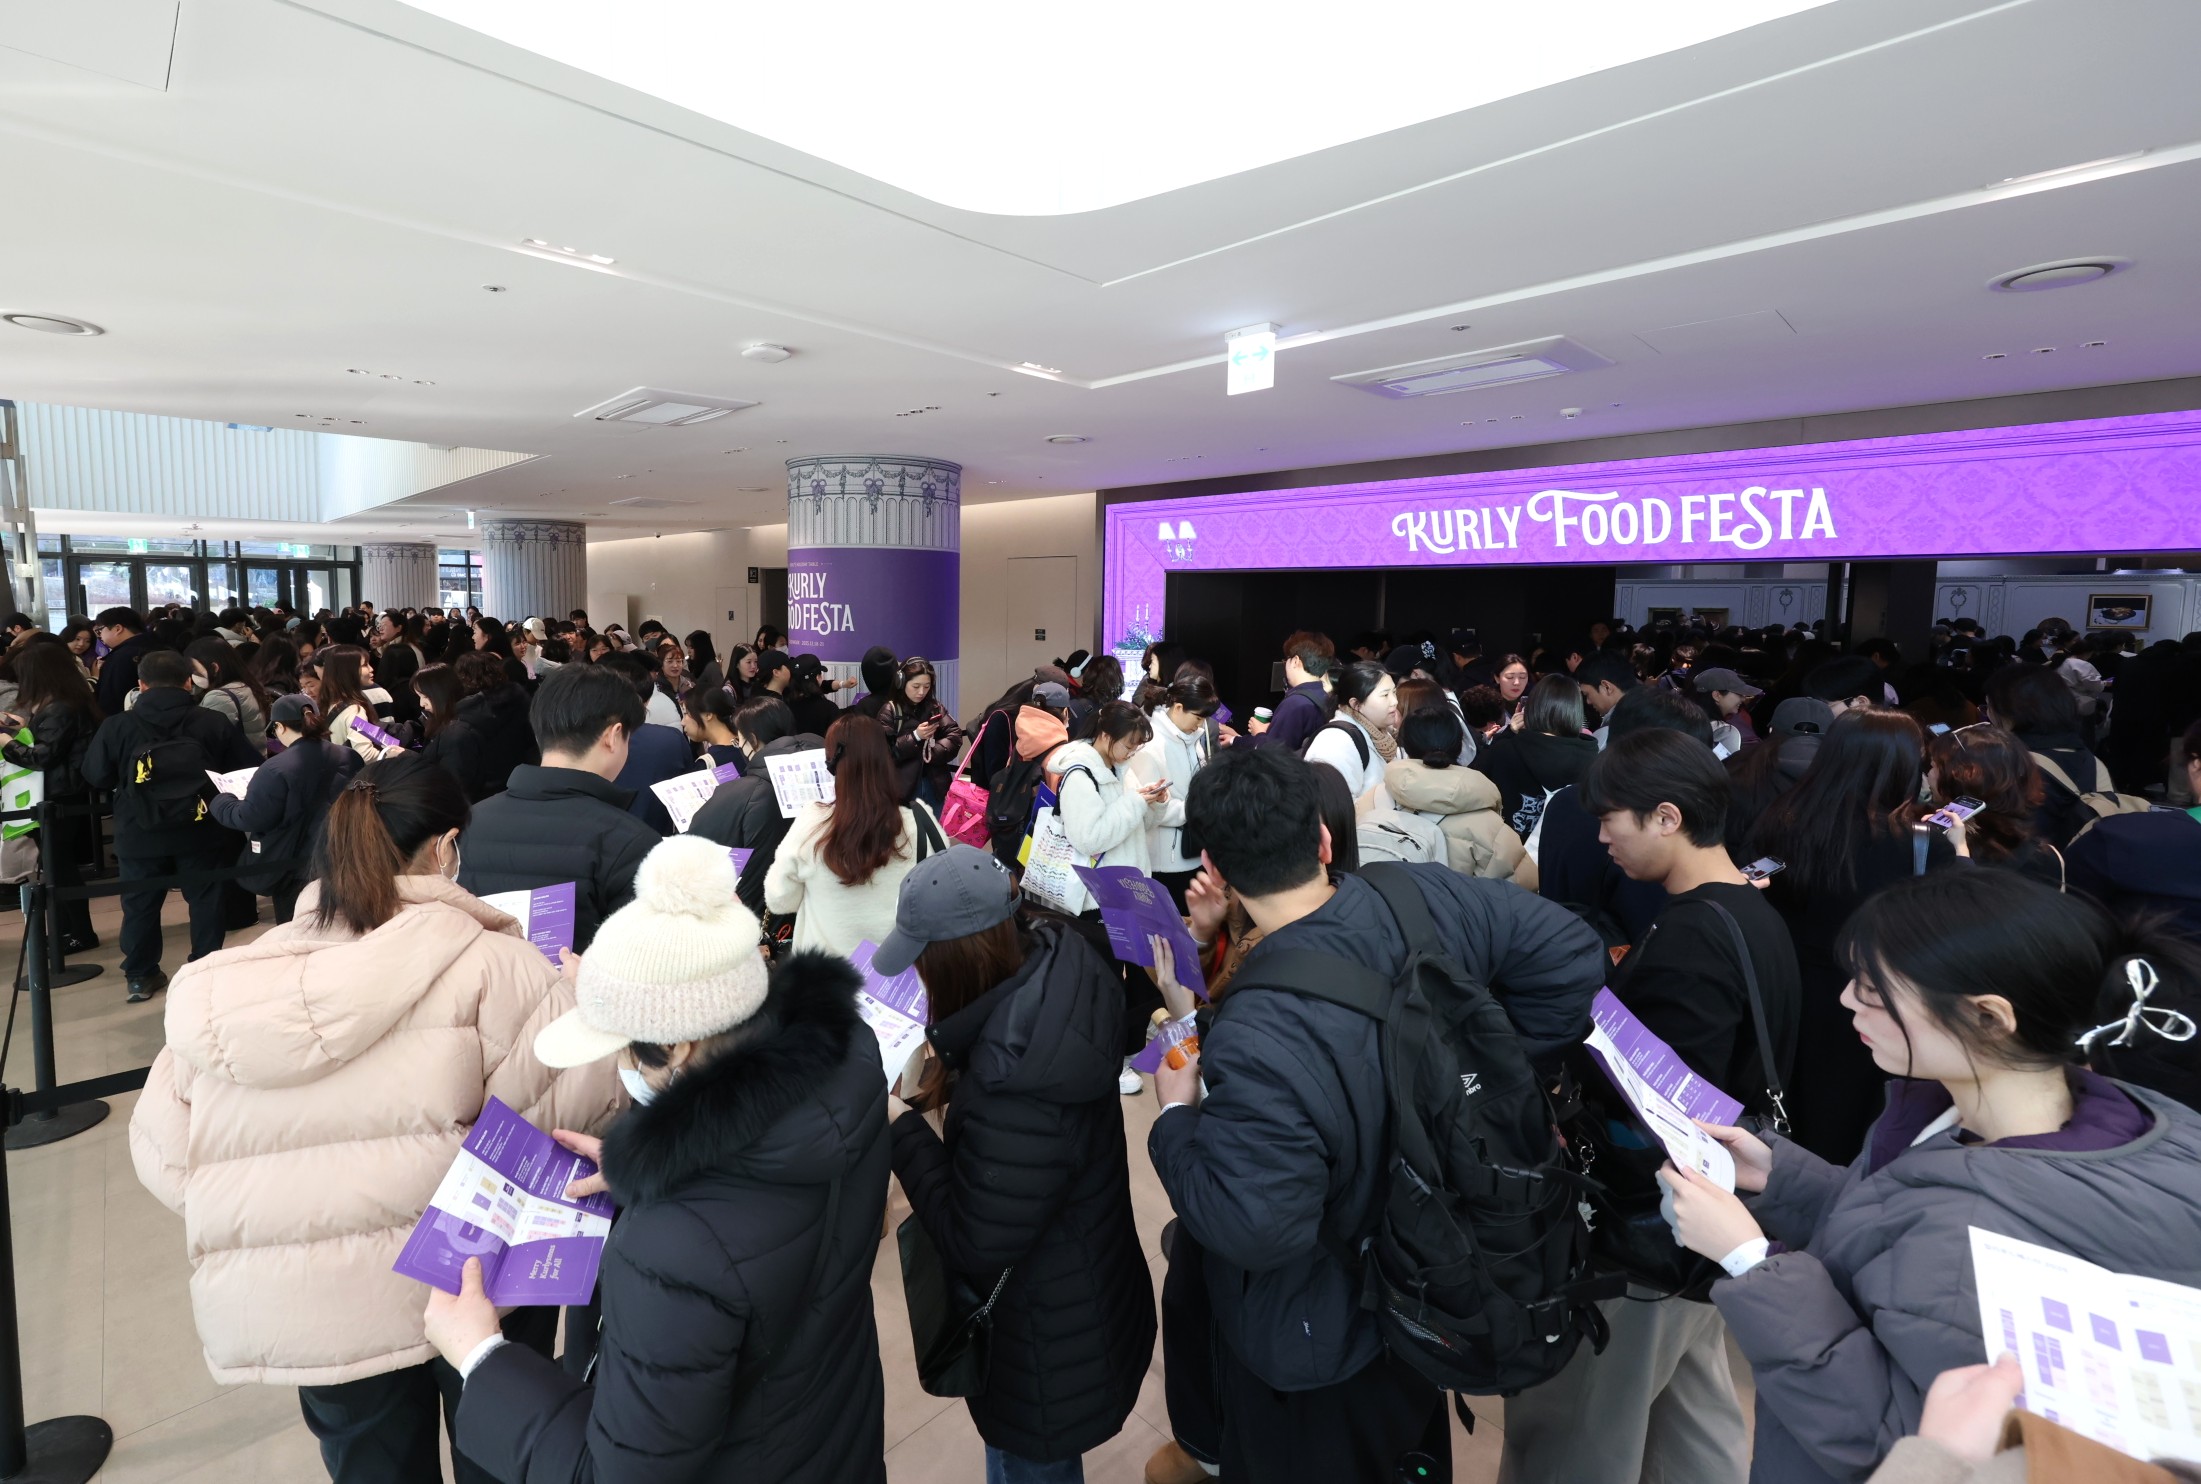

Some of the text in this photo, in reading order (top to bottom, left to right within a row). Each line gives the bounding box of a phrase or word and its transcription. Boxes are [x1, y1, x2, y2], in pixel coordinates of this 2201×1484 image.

[1392, 486, 1838, 554] KURLY FOOD FESTA
[788, 573, 826, 600] KURLY
[803, 601, 854, 635] FESTA
[529, 1259, 542, 1279] Merry
[550, 1258, 562, 1280] for All
